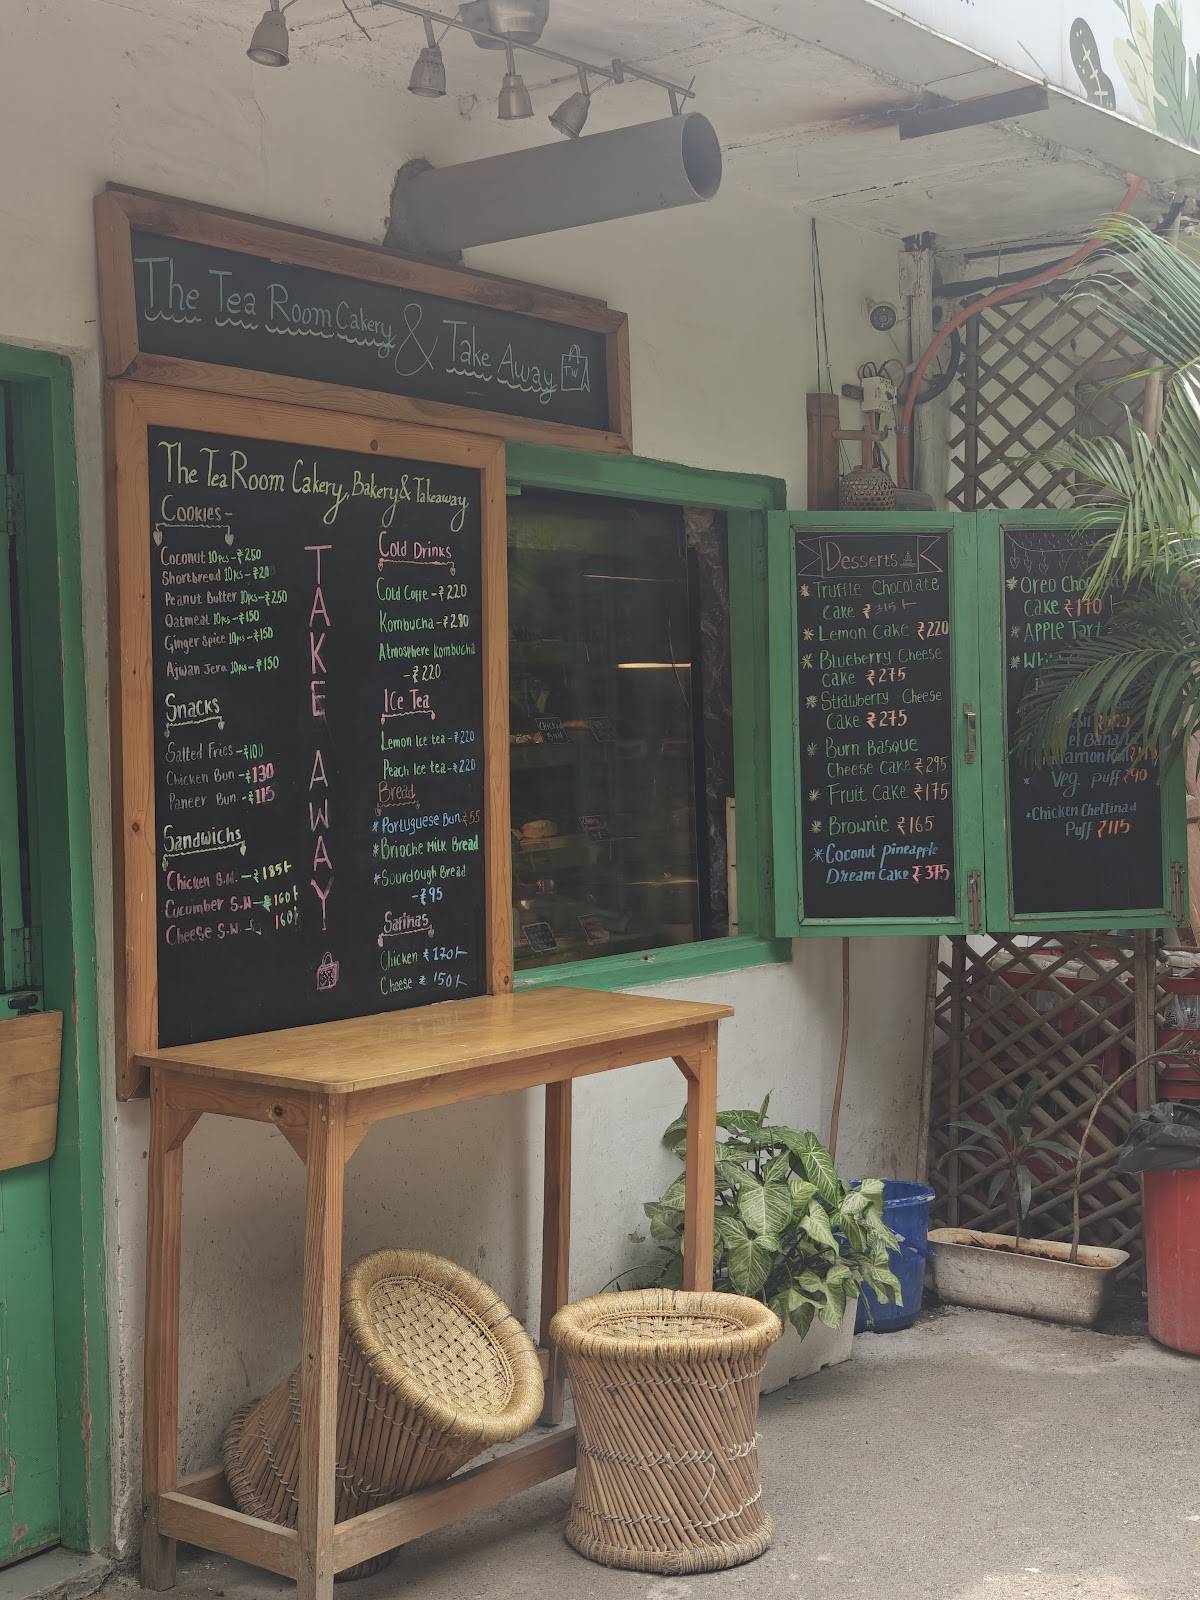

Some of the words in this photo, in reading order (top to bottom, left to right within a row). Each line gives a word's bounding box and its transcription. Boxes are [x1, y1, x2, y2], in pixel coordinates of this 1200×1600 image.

[134, 256, 200, 311] The
[208, 269, 257, 316] Tea
[266, 283, 332, 328] Room
[336, 301, 397, 359] Cakery
[396, 303, 438, 376] &
[442, 319, 492, 367] Take
[497, 343, 558, 404] Away
[158, 441, 199, 485] The
[200, 447, 228, 488] Tea
[230, 450, 284, 492] Room
[351, 470, 400, 528] Bakery
[400, 474, 411, 500] &
[413, 477, 470, 533] Takeaway
[160, 545, 206, 566] Coconut
[379, 531, 407, 558] Cold
[413, 541, 453, 559] Drinks
[825, 541, 898, 572] Desserts
[162, 568, 221, 586] Shortbread
[872, 577, 940, 596] Chocolate
[1020, 576, 1057, 595] Oreo
[165, 591, 204, 607] Peanut
[206, 590, 238, 605] Butter
[377, 577, 400, 601] Cold
[165, 613, 211, 628] Oatmeal
[304, 544, 333, 717] TAKE
[380, 609, 435, 633] Kombucha
[164, 634, 201, 654] Ginger
[202, 632, 226, 648] Spice
[818, 625, 867, 642] Lemon
[872, 623, 911, 640] Cake
[379, 642, 430, 662] Atmosphere
[819, 650, 891, 670] Blueberry
[898, 648, 944, 664] Cheese
[165, 692, 220, 722] Snacks
[384, 688, 404, 713] Ice
[409, 688, 431, 710] Tea
[820, 690, 889, 711] Strawberry
[902, 688, 943, 705] Cheese
[826, 713, 862, 731] Cake
[165, 741, 203, 763] Salted
[208, 741, 234, 760] Fries
[381, 730, 412, 752] Lemon
[431, 733, 446, 745] tea
[825, 736, 860, 759] Burn
[166, 770, 209, 786] Chicken
[213, 768, 236, 783] Bun
[383, 758, 410, 780] Peach
[430, 760, 447, 774] tea
[827, 761, 874, 778] Cheese
[879, 759, 911, 775] Cake
[169, 792, 207, 811] Paneer
[216, 792, 237, 806] Bun
[378, 780, 416, 803] Bread
[826, 782, 867, 806] Fruit
[872, 784, 909, 801] Cake
[381, 816, 440, 835] Portuguese
[442, 812, 461, 827] Bun
[1031, 804, 1079, 821] Chicken
[829, 814, 890, 836] Brownie
[163, 825, 242, 853] Sandwichs
[380, 836, 424, 860] Brioche
[451, 834, 480, 852] Bread
[825, 842, 876, 864] Coconut
[166, 870, 211, 892] Chicken
[381, 868, 437, 886] Sourdough
[439, 864, 466, 879] Bread
[826, 867, 876, 885] Dream
[878, 867, 910, 881] Cake
[164, 898, 224, 919] Cucumber
[165, 924, 213, 946] Cheese
[380, 950, 418, 971] Chicken
